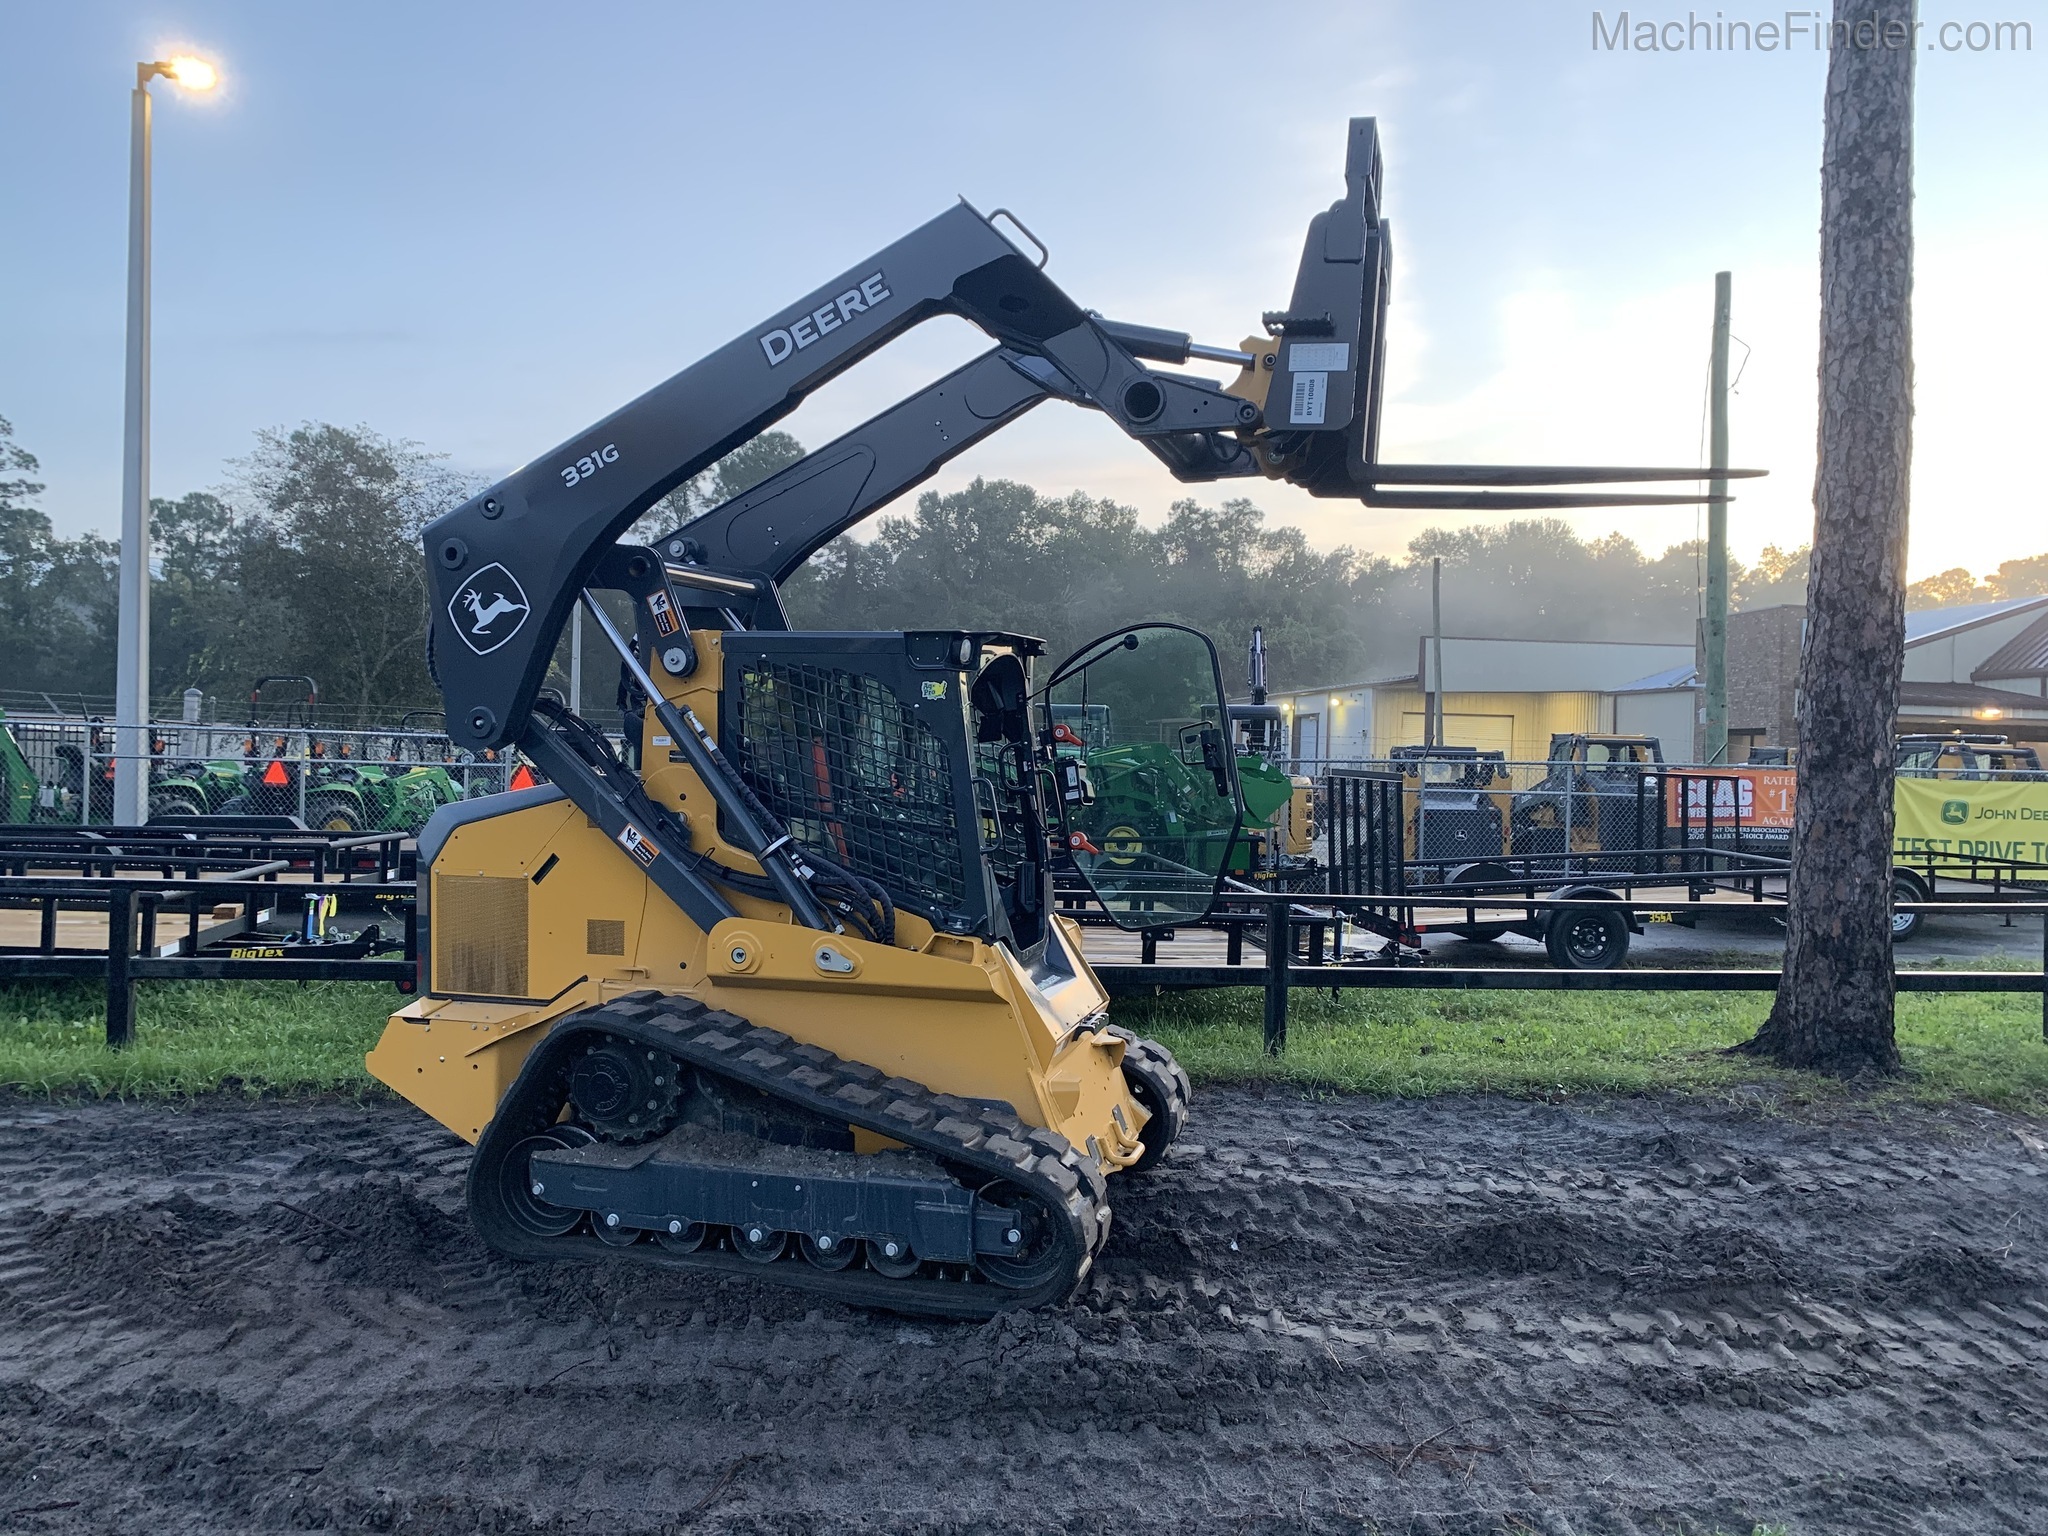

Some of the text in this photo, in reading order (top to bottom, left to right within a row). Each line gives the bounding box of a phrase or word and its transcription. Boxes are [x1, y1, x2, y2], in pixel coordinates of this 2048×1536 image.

[760, 271, 891, 367] DEERE
[560, 443, 620, 488] 331G
[1974, 807, 2017, 820] JOHN
[1897, 837, 1952, 862] TEST
[230, 947, 284, 959] BigTex
